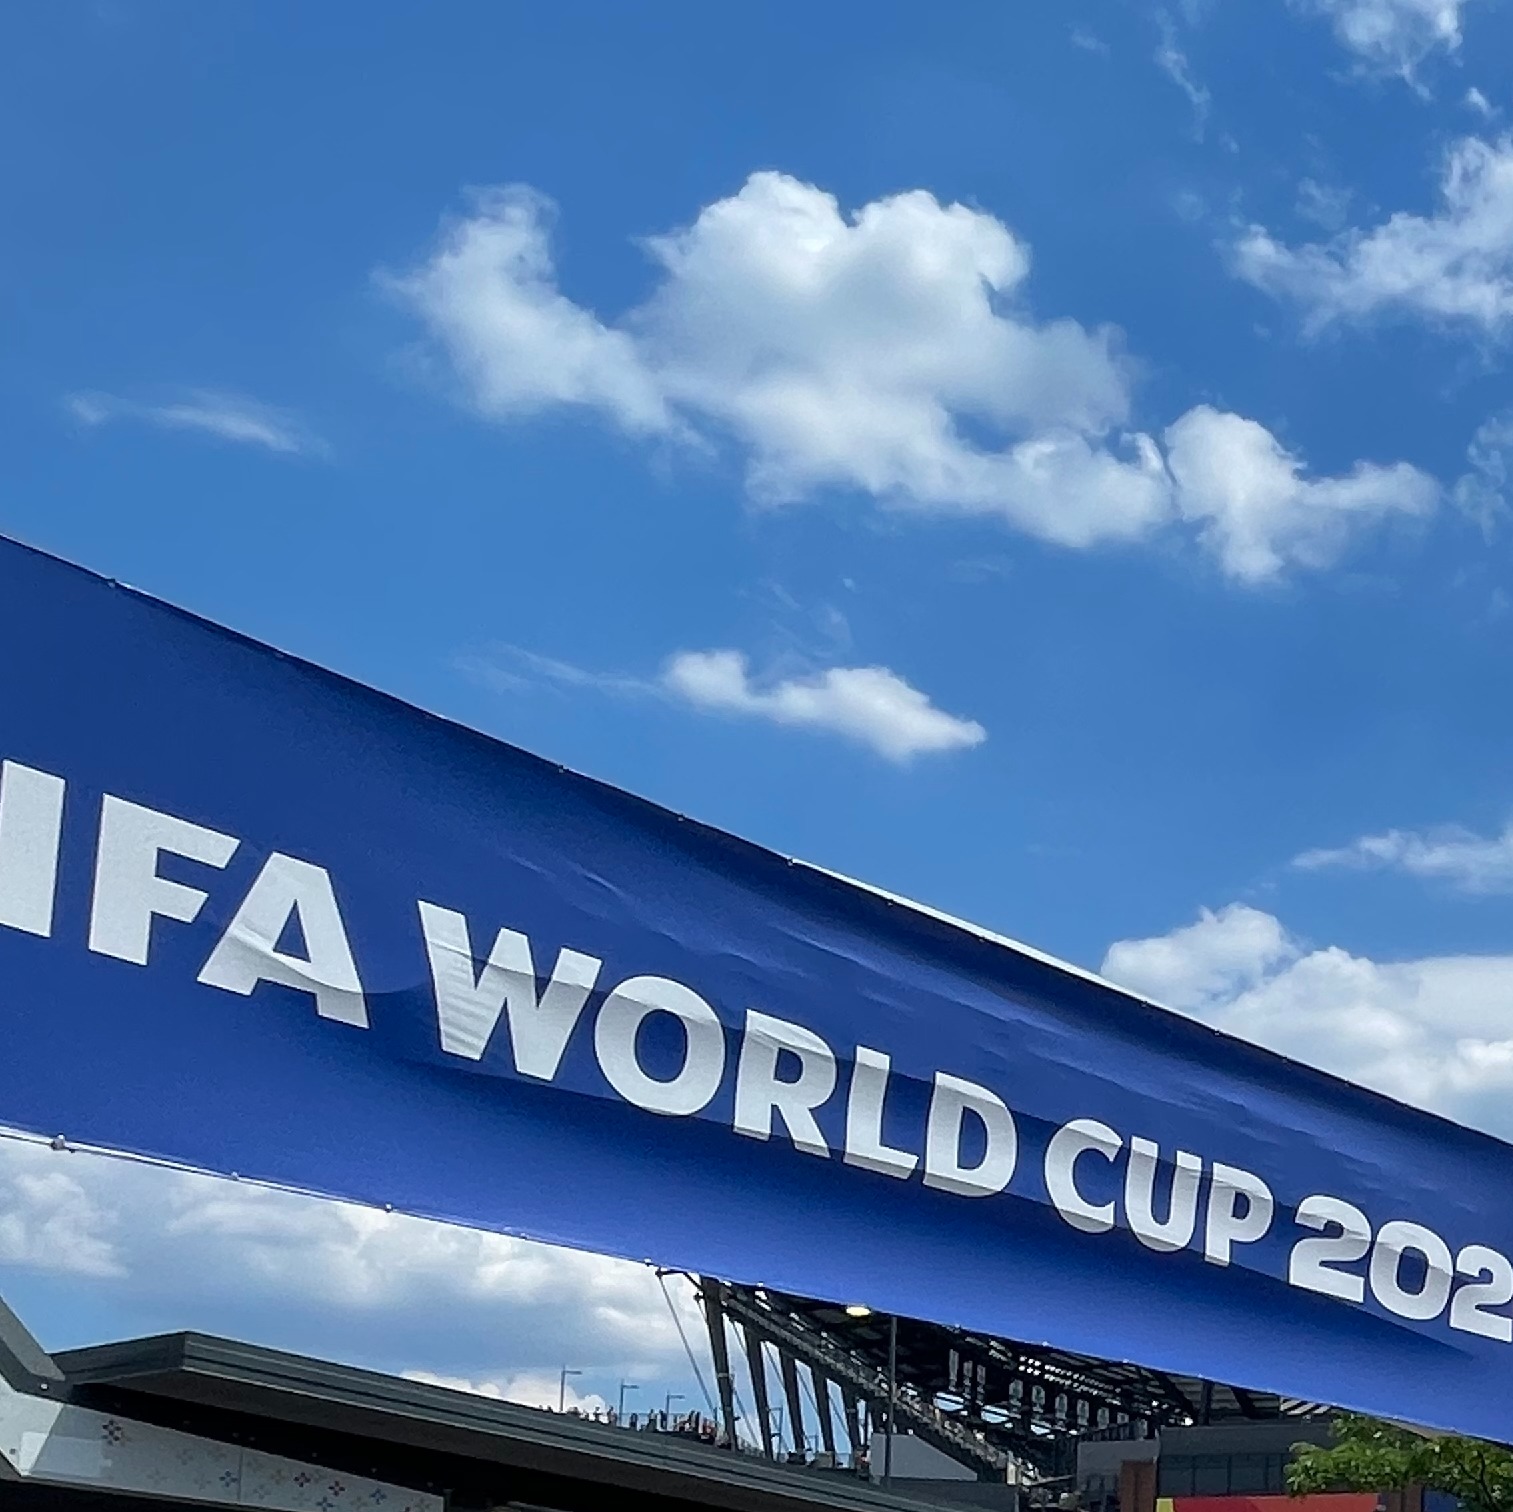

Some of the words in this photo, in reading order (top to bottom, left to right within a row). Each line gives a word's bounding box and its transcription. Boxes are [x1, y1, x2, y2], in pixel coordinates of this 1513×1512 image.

[0, 758, 370, 1030] IFA
[417, 899, 1018, 1198] WORLD
[1043, 1117, 1274, 1267] CUP
